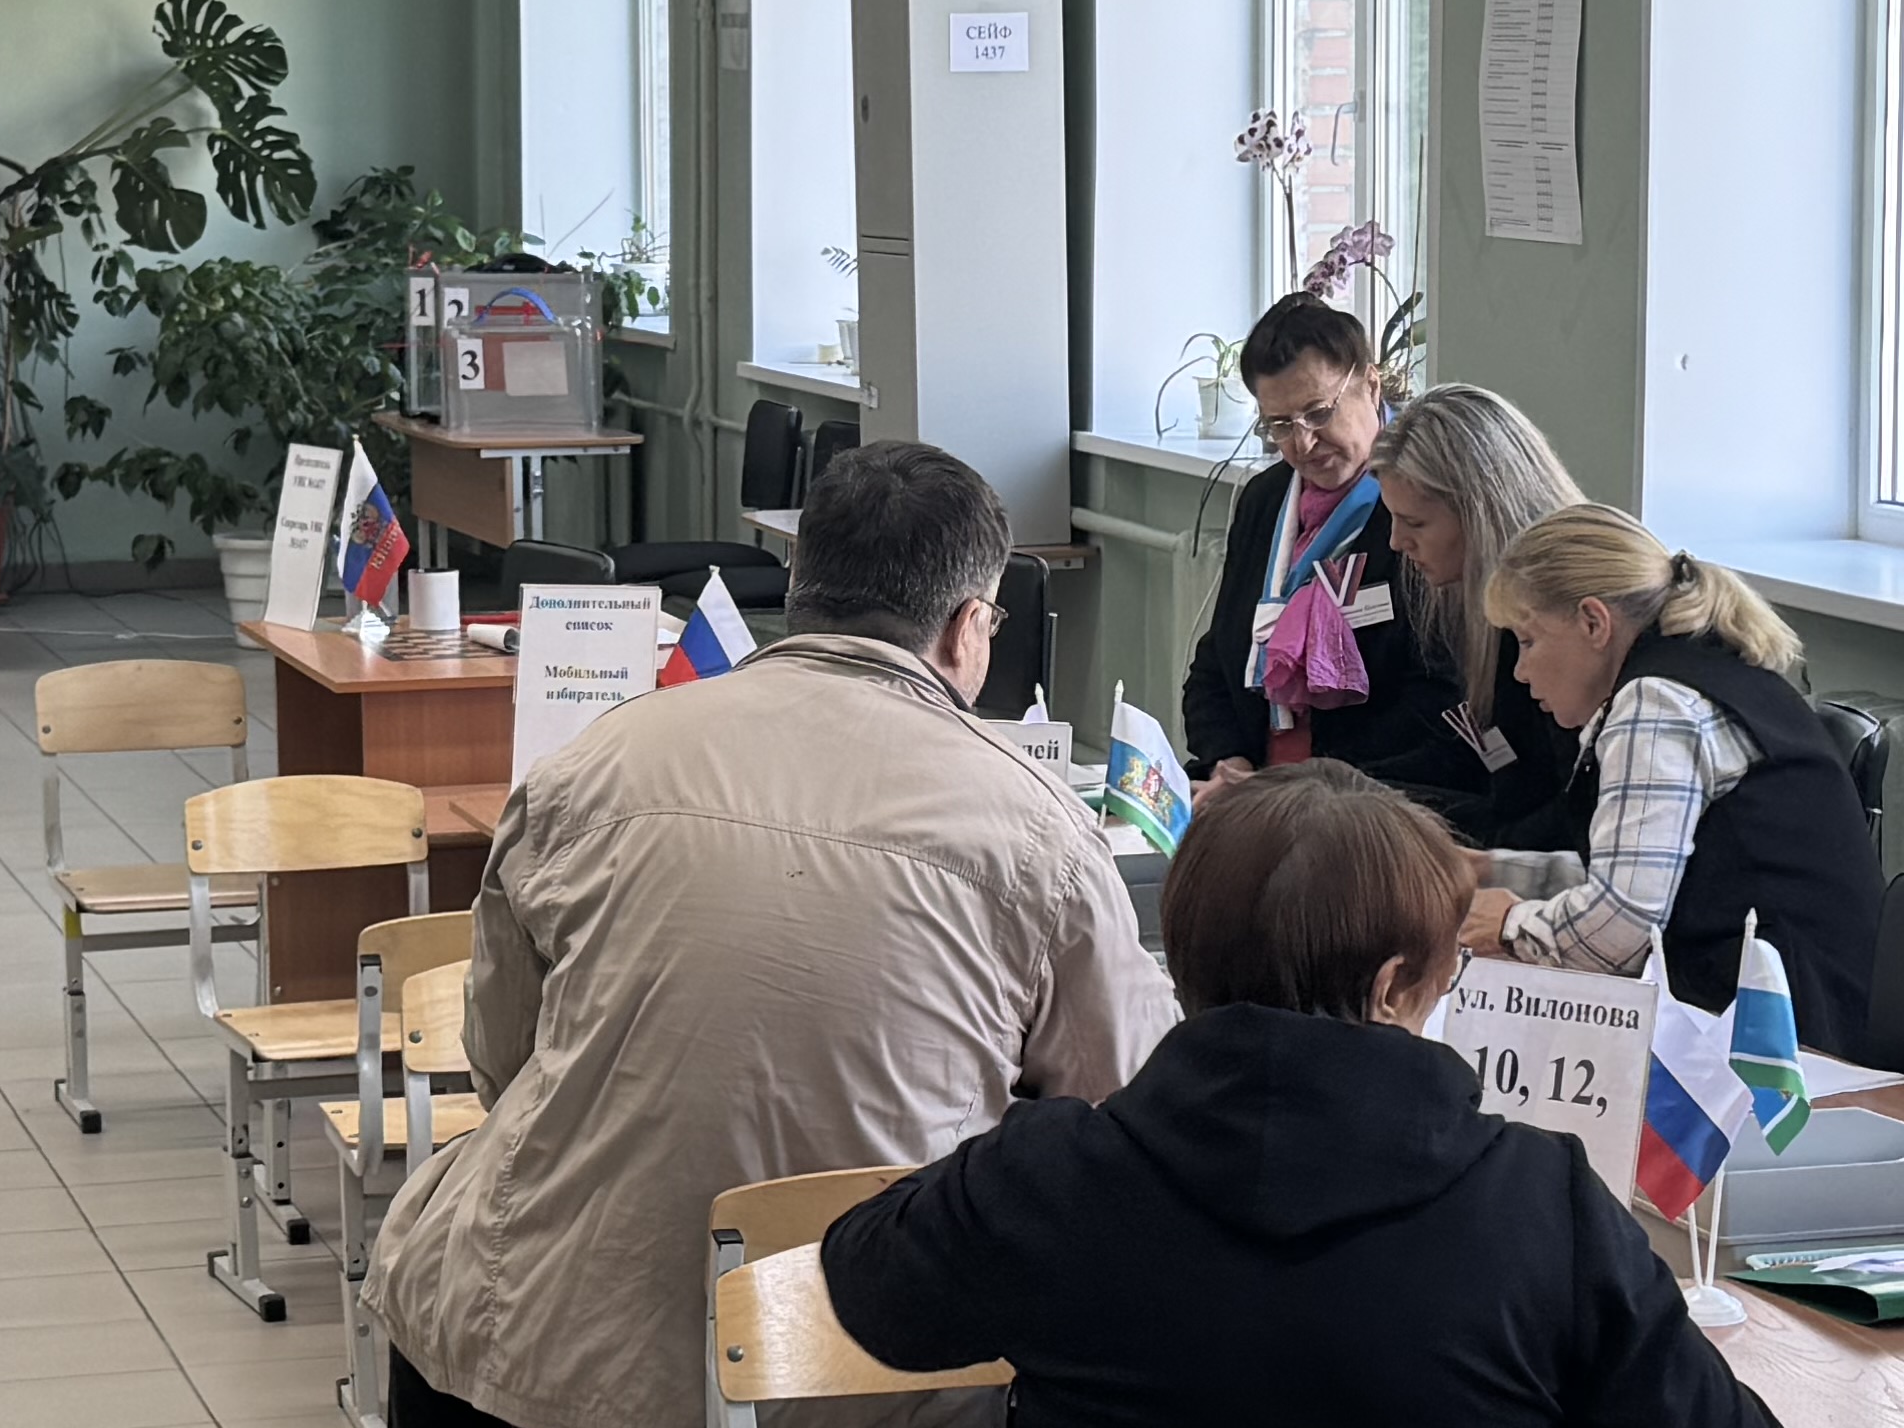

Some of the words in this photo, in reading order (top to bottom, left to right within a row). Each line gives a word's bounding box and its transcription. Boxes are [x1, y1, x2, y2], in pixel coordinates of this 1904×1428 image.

[975, 44, 1006, 60] 1437
[416, 288, 427, 318] 1
[461, 349, 481, 381] 3
[1455, 986, 1495, 1015] ул.
[1505, 985, 1641, 1031] Вилонова
[1473, 1045, 1530, 1108] 10,
[1546, 1055, 1609, 1119] 12,
